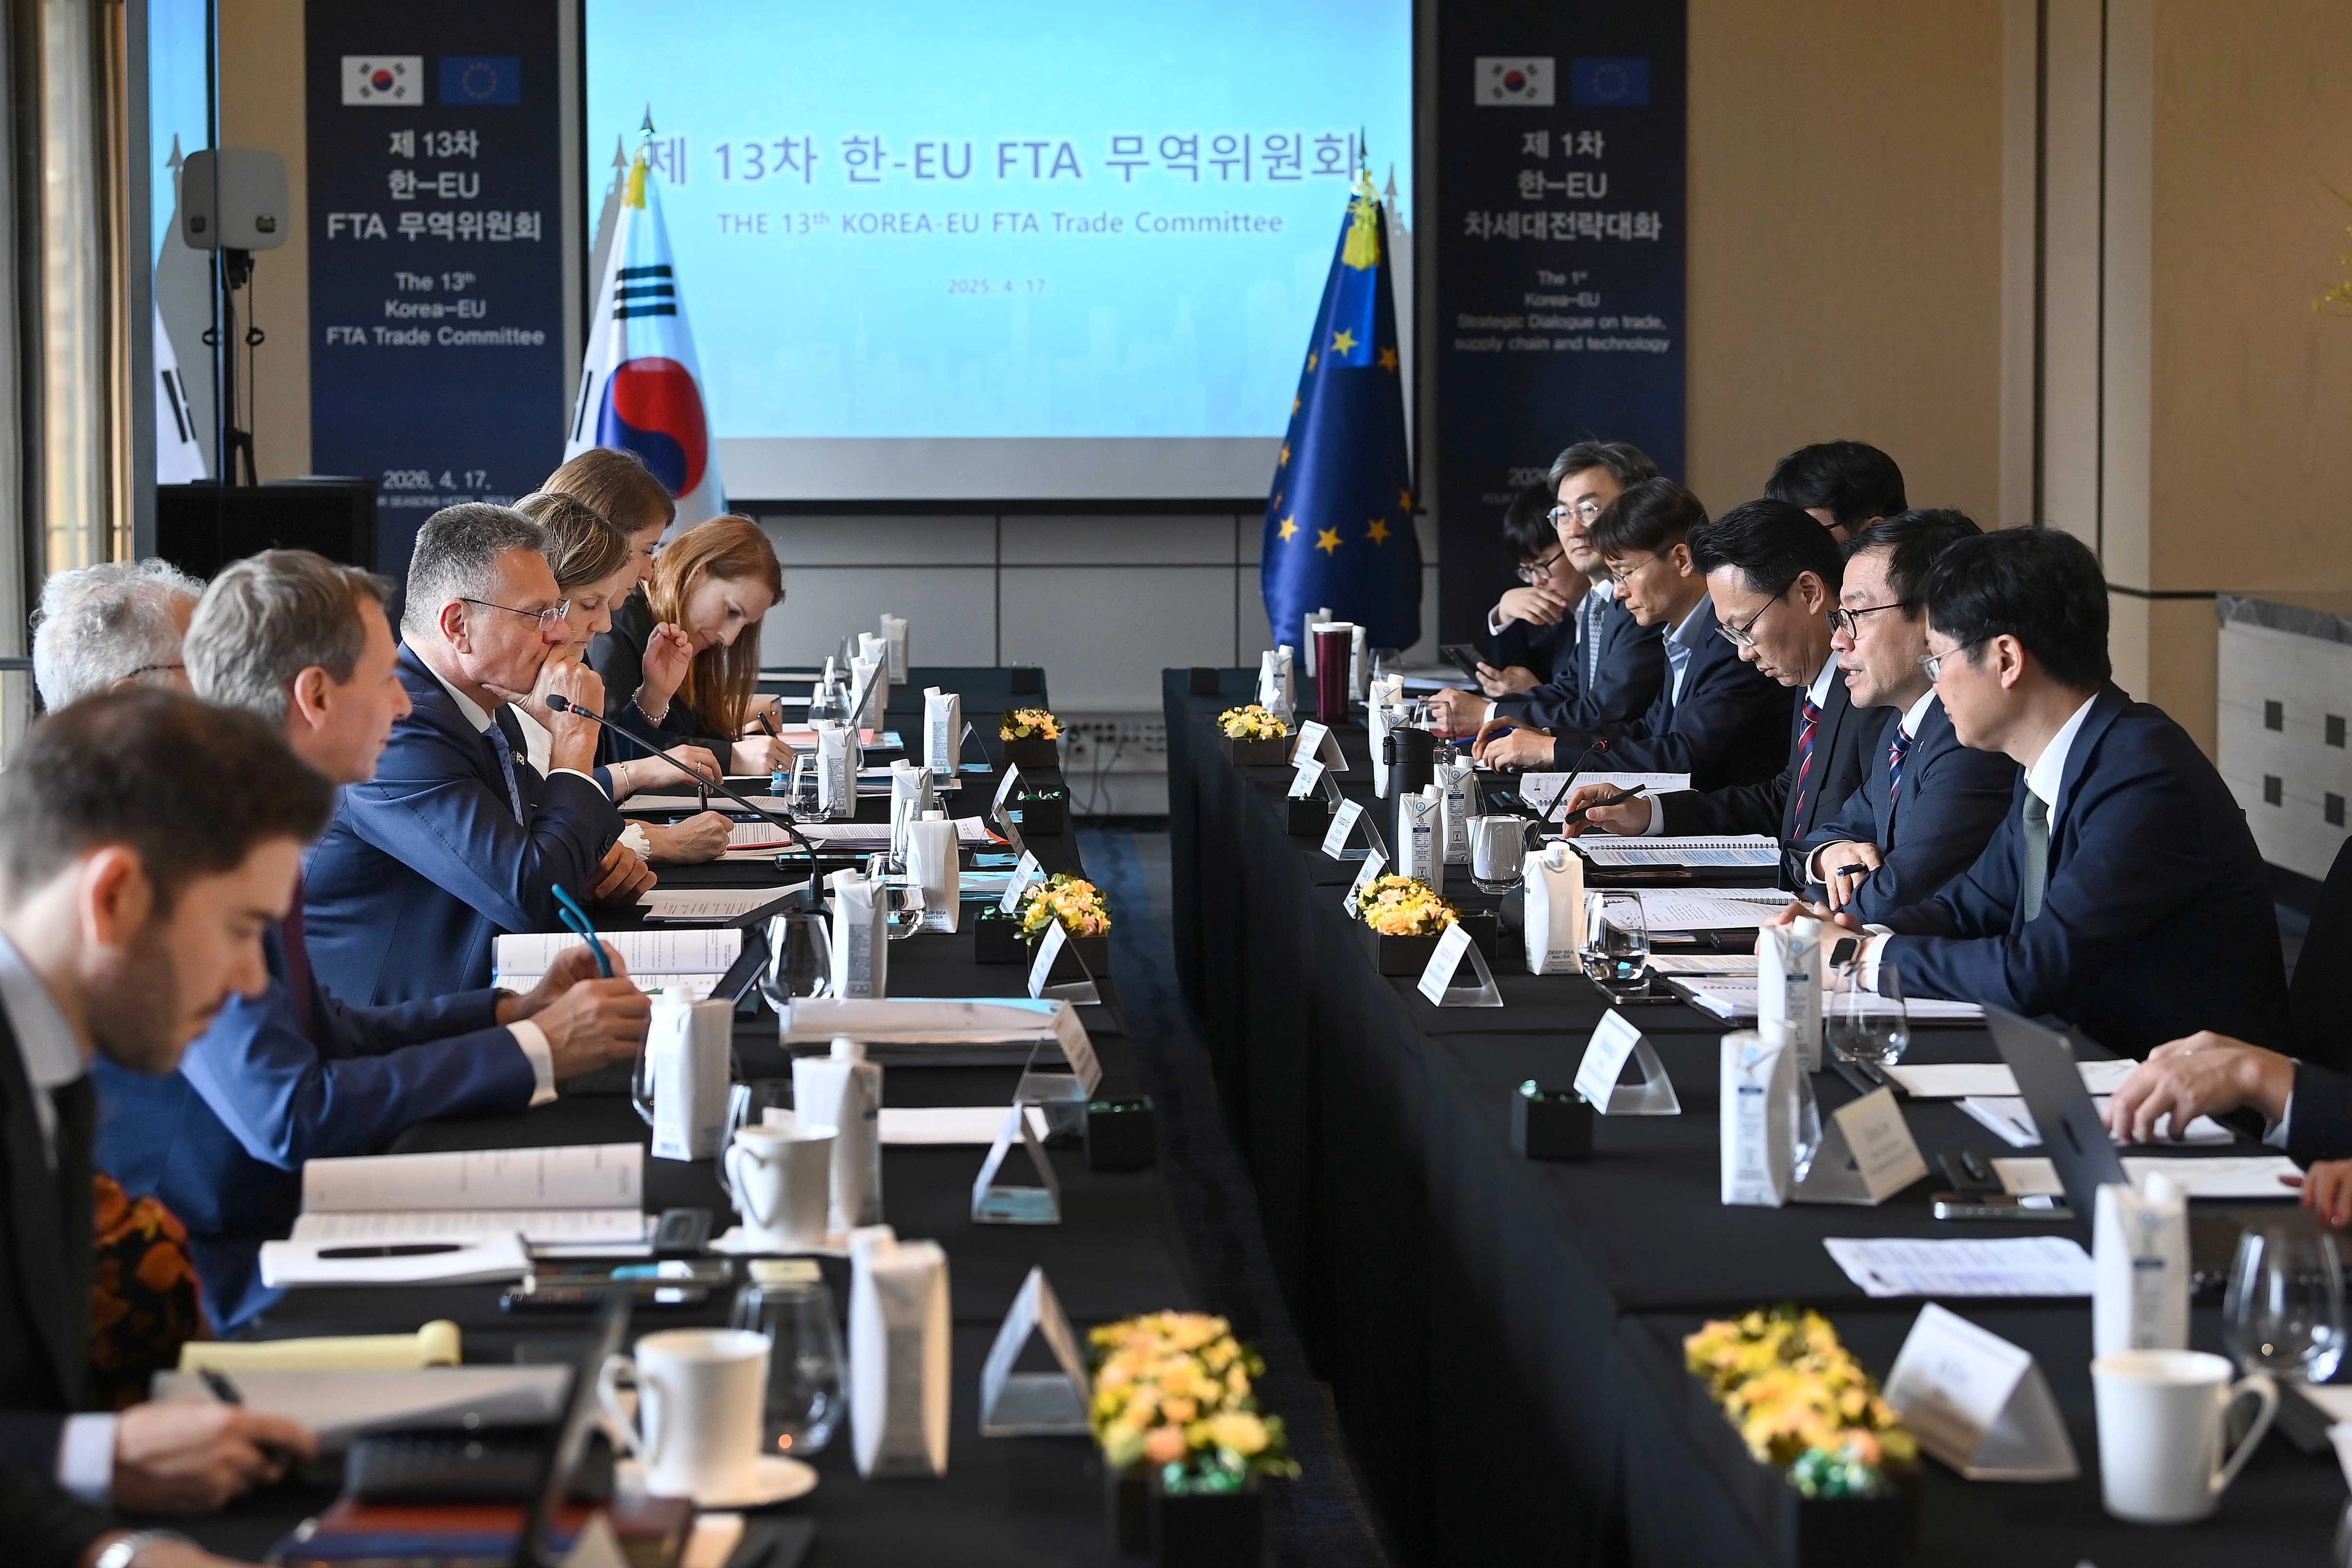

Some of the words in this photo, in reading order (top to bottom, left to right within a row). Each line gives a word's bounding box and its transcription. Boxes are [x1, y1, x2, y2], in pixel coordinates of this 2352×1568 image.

[389, 130, 415, 159] 제
[423, 130, 479, 159] 13차
[1522, 131, 1549, 159] 제
[1561, 131, 1606, 159] 1차
[651, 136, 686, 185] 제
[715, 136, 818, 184] 13차
[841, 135, 973, 183] 한-EU
[997, 142, 1083, 181] FTA
[1105, 133, 1354, 182] 무역위원회
[389, 170, 479, 200] 한-EU
[1518, 170, 1608, 200] 한-EU
[327, 212, 387, 239] FTA
[397, 211, 541, 242] 무역위원회
[717, 213, 769, 234] THE
[781, 210, 830, 234] 13th
[842, 212, 979, 234] KOREA-EU
[994, 213, 1040, 233] FTA
[1050, 211, 1124, 233] Trade
[1135, 210, 1284, 233] Committee
[1464, 211, 1663, 242] 차세대전략대화
[395, 272, 433, 292] The
[1537, 270, 1566, 286] The
[385, 299, 487, 319] Korea-EU
[1524, 292, 1601, 308] Korea-EU
[326, 326, 368, 346] FTA
[373, 326, 431, 346] Trade
[437, 326, 546, 346] Committee
[1553, 336, 1584, 351] and
[464, 470, 493, 490] 17.
